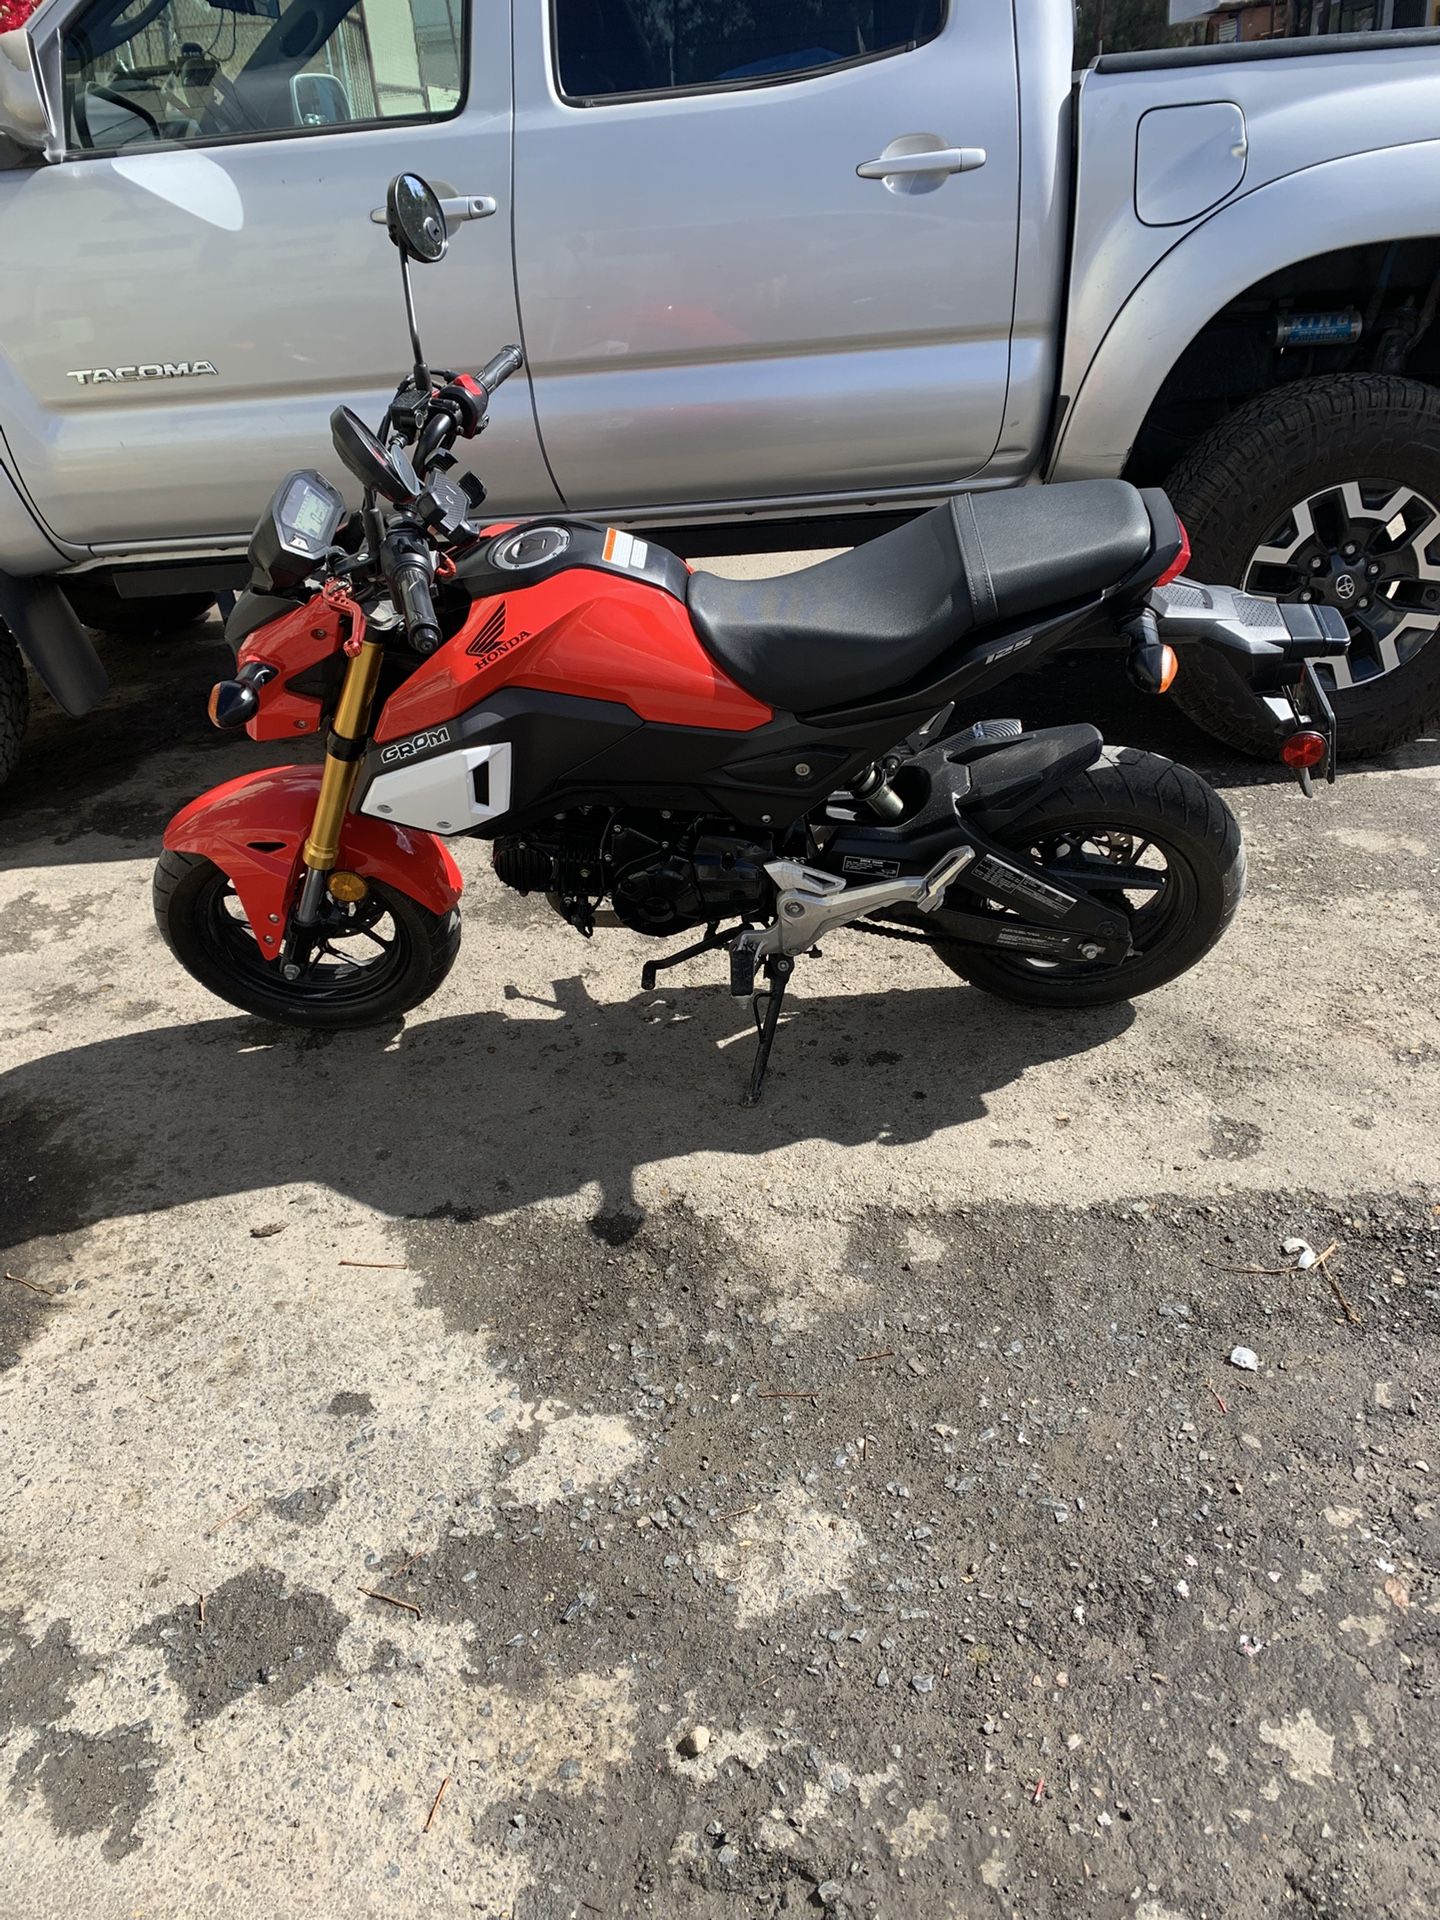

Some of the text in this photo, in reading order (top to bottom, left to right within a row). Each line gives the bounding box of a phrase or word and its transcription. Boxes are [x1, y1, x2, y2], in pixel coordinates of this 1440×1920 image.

[66, 360, 219, 385] TACOMA
[474, 630, 532, 670] HONDA
[985, 634, 1033, 665] 125
[381, 727, 450, 763] GROM
